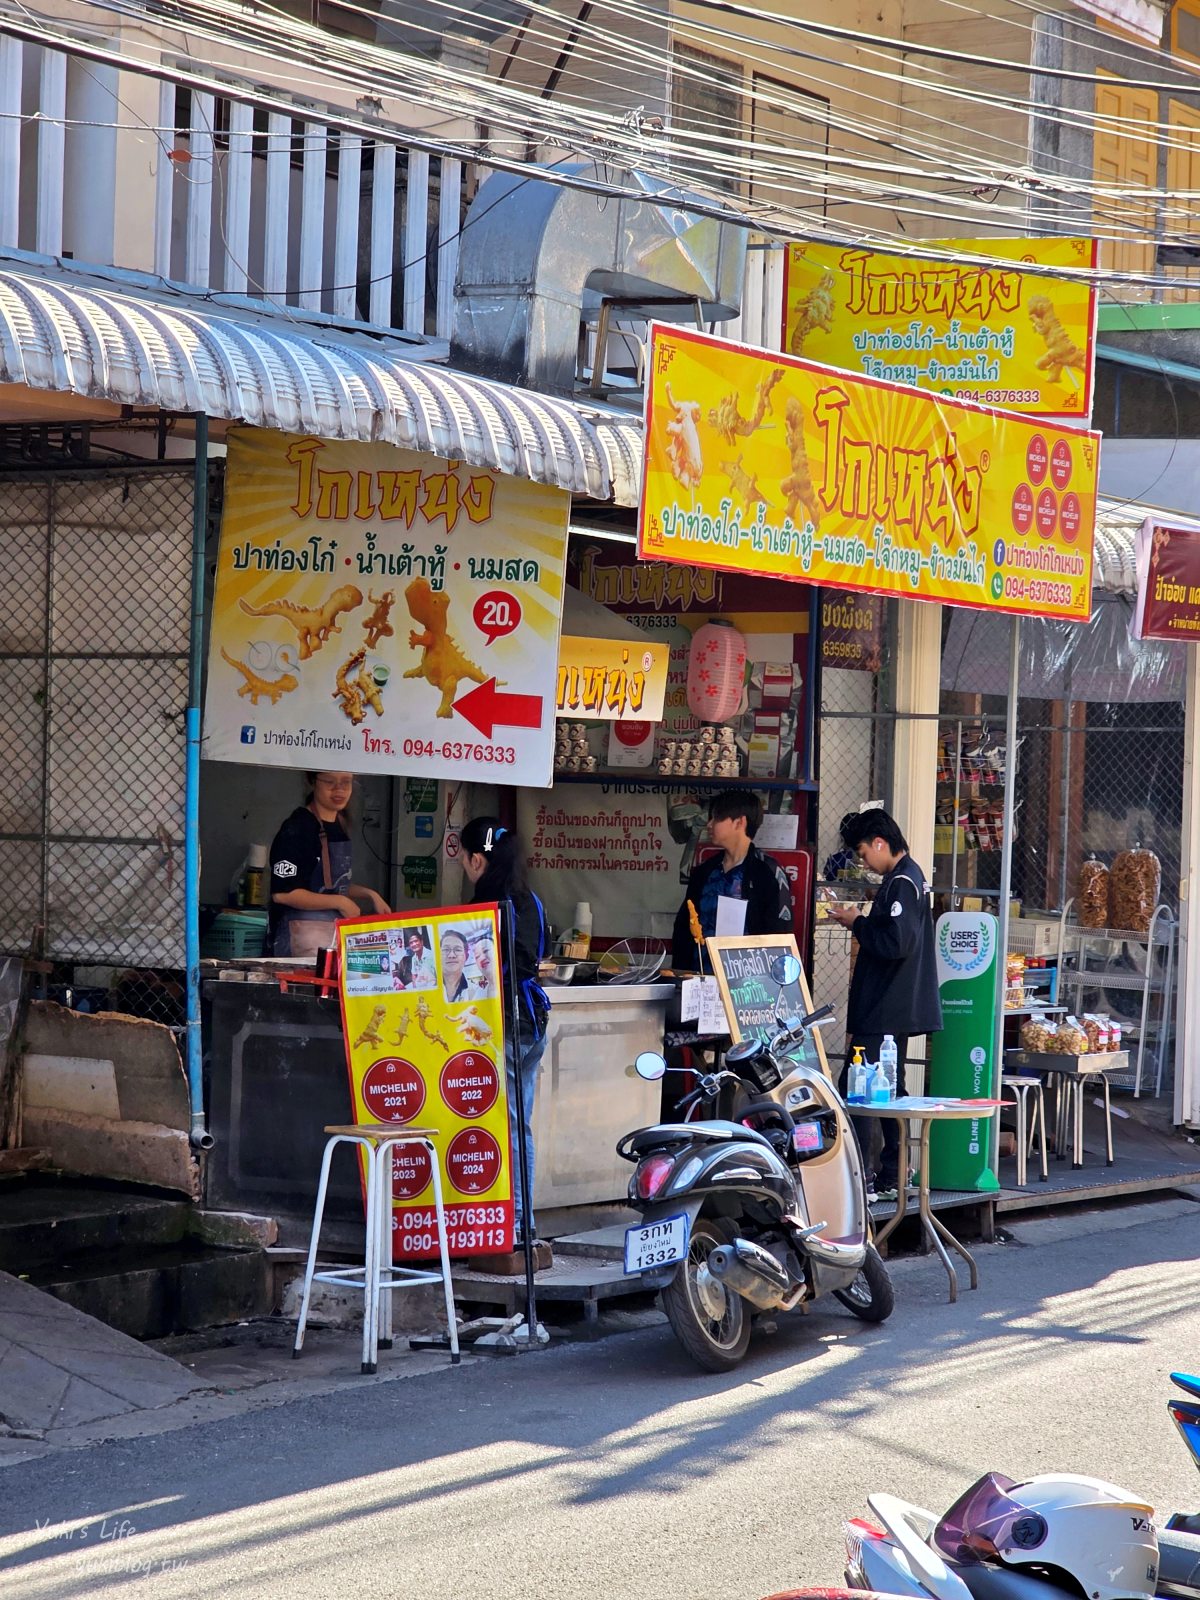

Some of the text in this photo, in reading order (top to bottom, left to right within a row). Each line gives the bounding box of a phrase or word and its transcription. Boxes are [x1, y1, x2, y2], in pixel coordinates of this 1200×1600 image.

[956, 390, 1040, 404] 094-6376333
[813, 385, 982, 548] โกเหน่ง
[233, 531, 539, 591] ปาท่องโก๋ น้ำเต้าหู้ นมสด
[1005, 576, 1072, 605] 094-6376333
[263, 728, 516, 764] ปาท่องโก๋โกเหน่ง โทร. 094-6376333
[274, 863, 295, 875] 2023
[950, 940, 978, 948] CHOICE
[369, 1082, 418, 1095] MICHELIN
[447, 1075, 492, 1089] MICHELIN
[384, 1096, 407, 1107] 2021
[461, 1090, 483, 1101] 2022
[391, 1156, 426, 1168] CHELIN
[452, 1151, 495, 1163] MICHELIN
[393, 1169, 416, 1180] 2023
[463, 1165, 484, 1175] 2024
[640, 1222, 673, 1242] 3กท
[403, 1229, 505, 1252] 090-193113
[640, 1236, 671, 1253] เชียงใหม่
[636, 1247, 677, 1268] 1332
